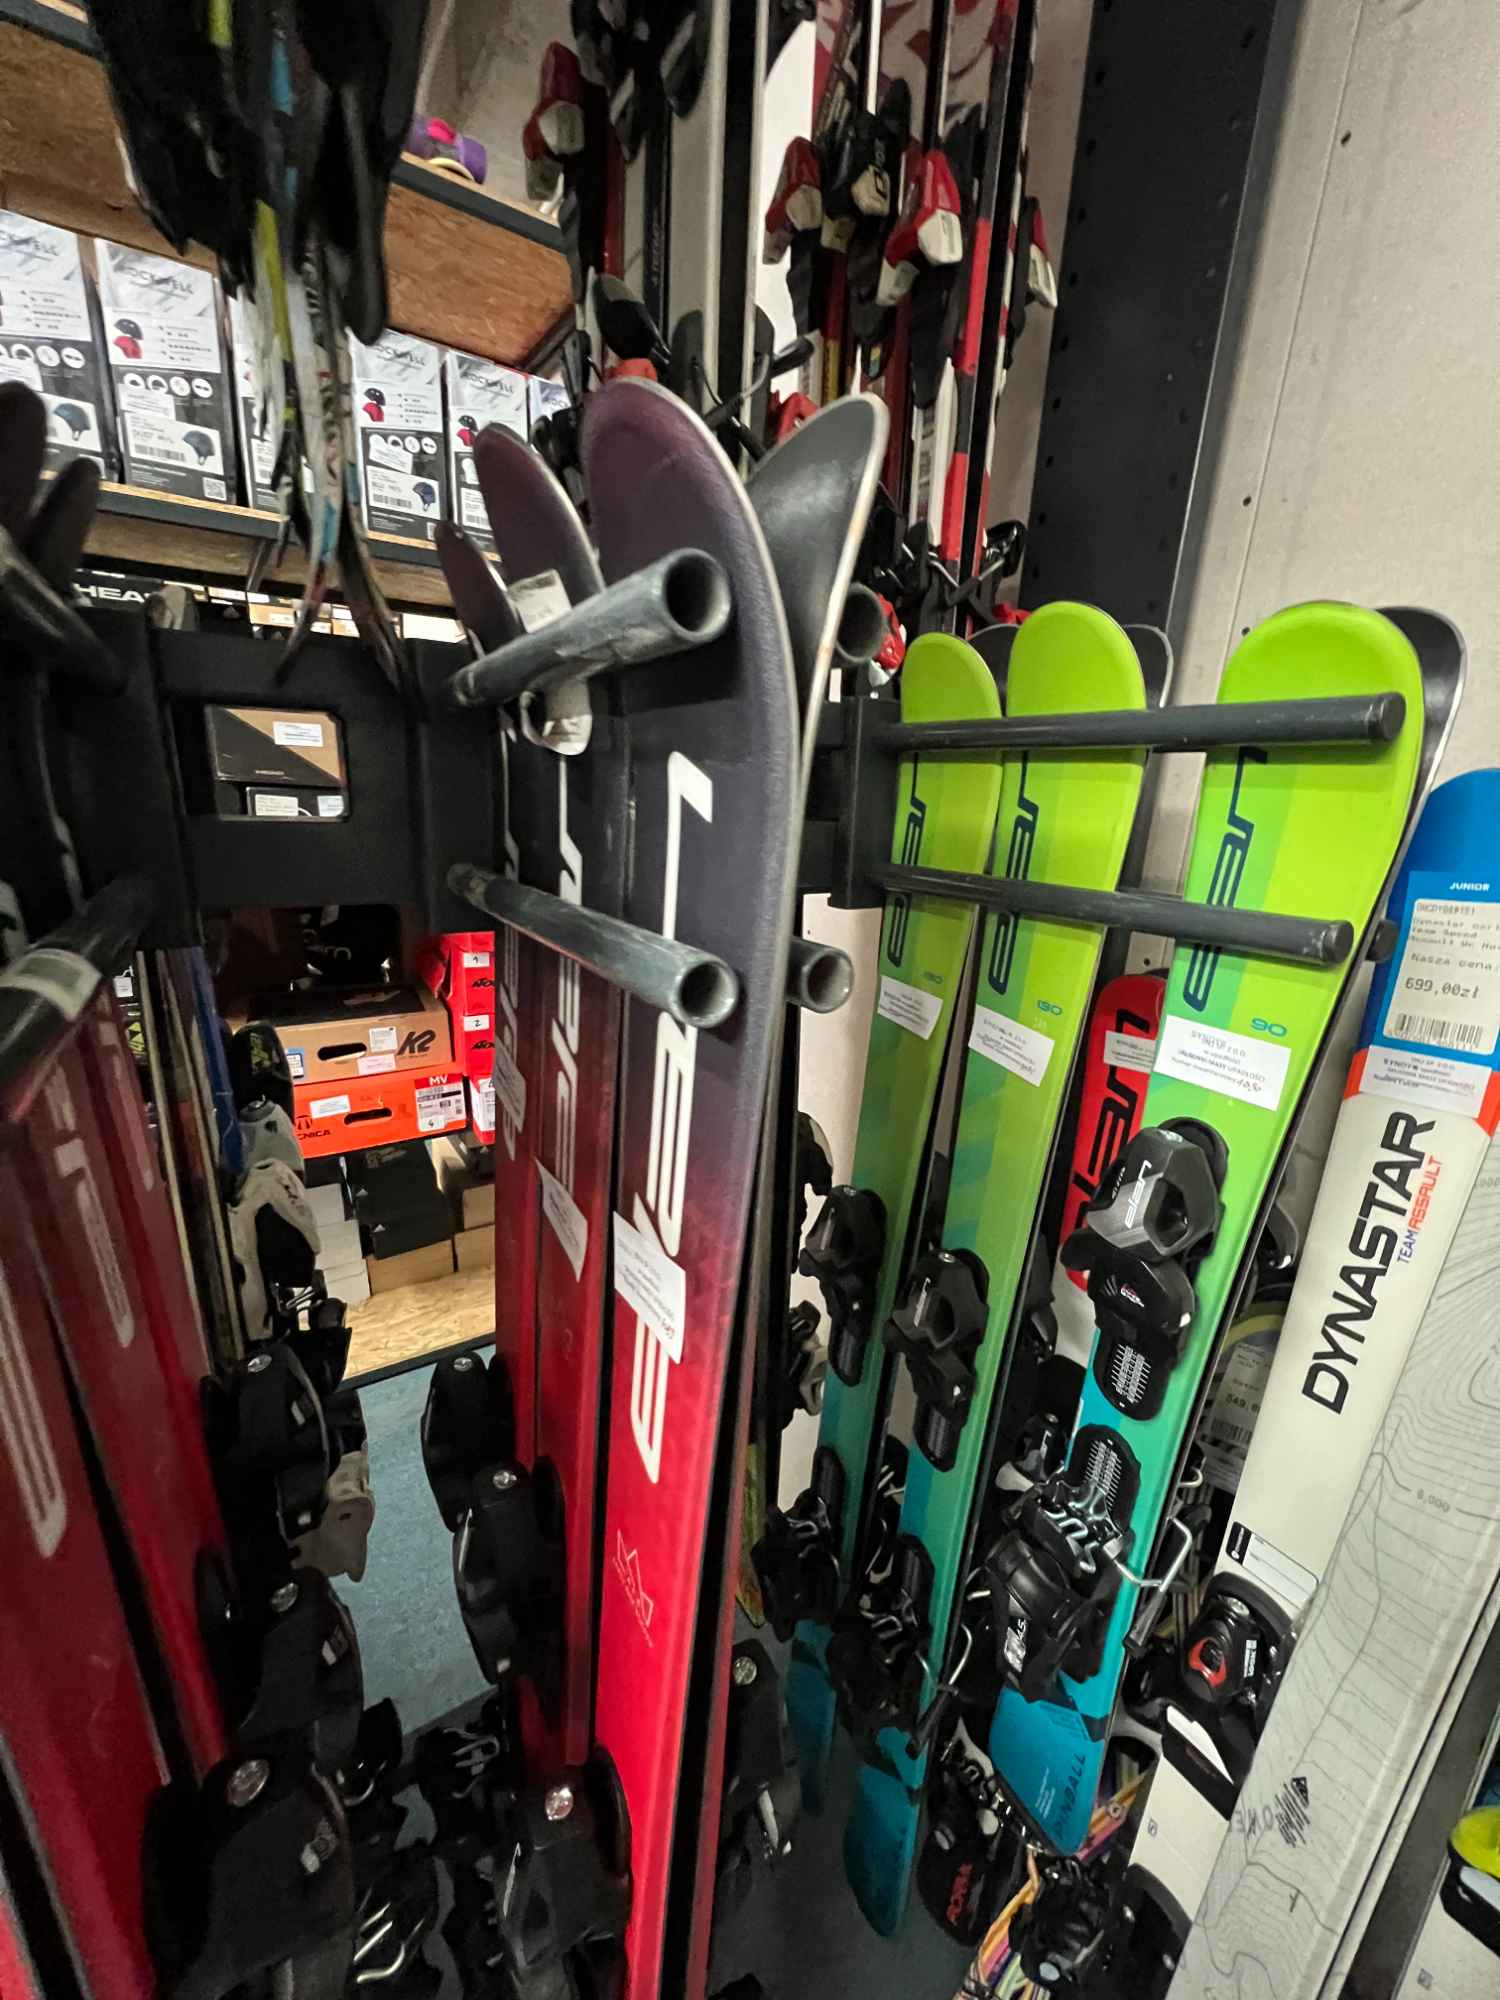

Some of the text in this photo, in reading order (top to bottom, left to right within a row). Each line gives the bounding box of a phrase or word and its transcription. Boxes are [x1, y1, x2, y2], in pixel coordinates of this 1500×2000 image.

[74, 583, 150, 604] HEA
[1449, 882, 1490, 892] JUNIOR
[1250, 1016, 1287, 1037] 90
[397, 1029, 436, 1056] K2
[429, 1075, 448, 1087] MV
[1124, 1159, 1153, 1229] elan
[1397, 1155, 1443, 1263] TEAM ASSAULT
[1302, 1112, 1436, 1415] DYNASTAR
